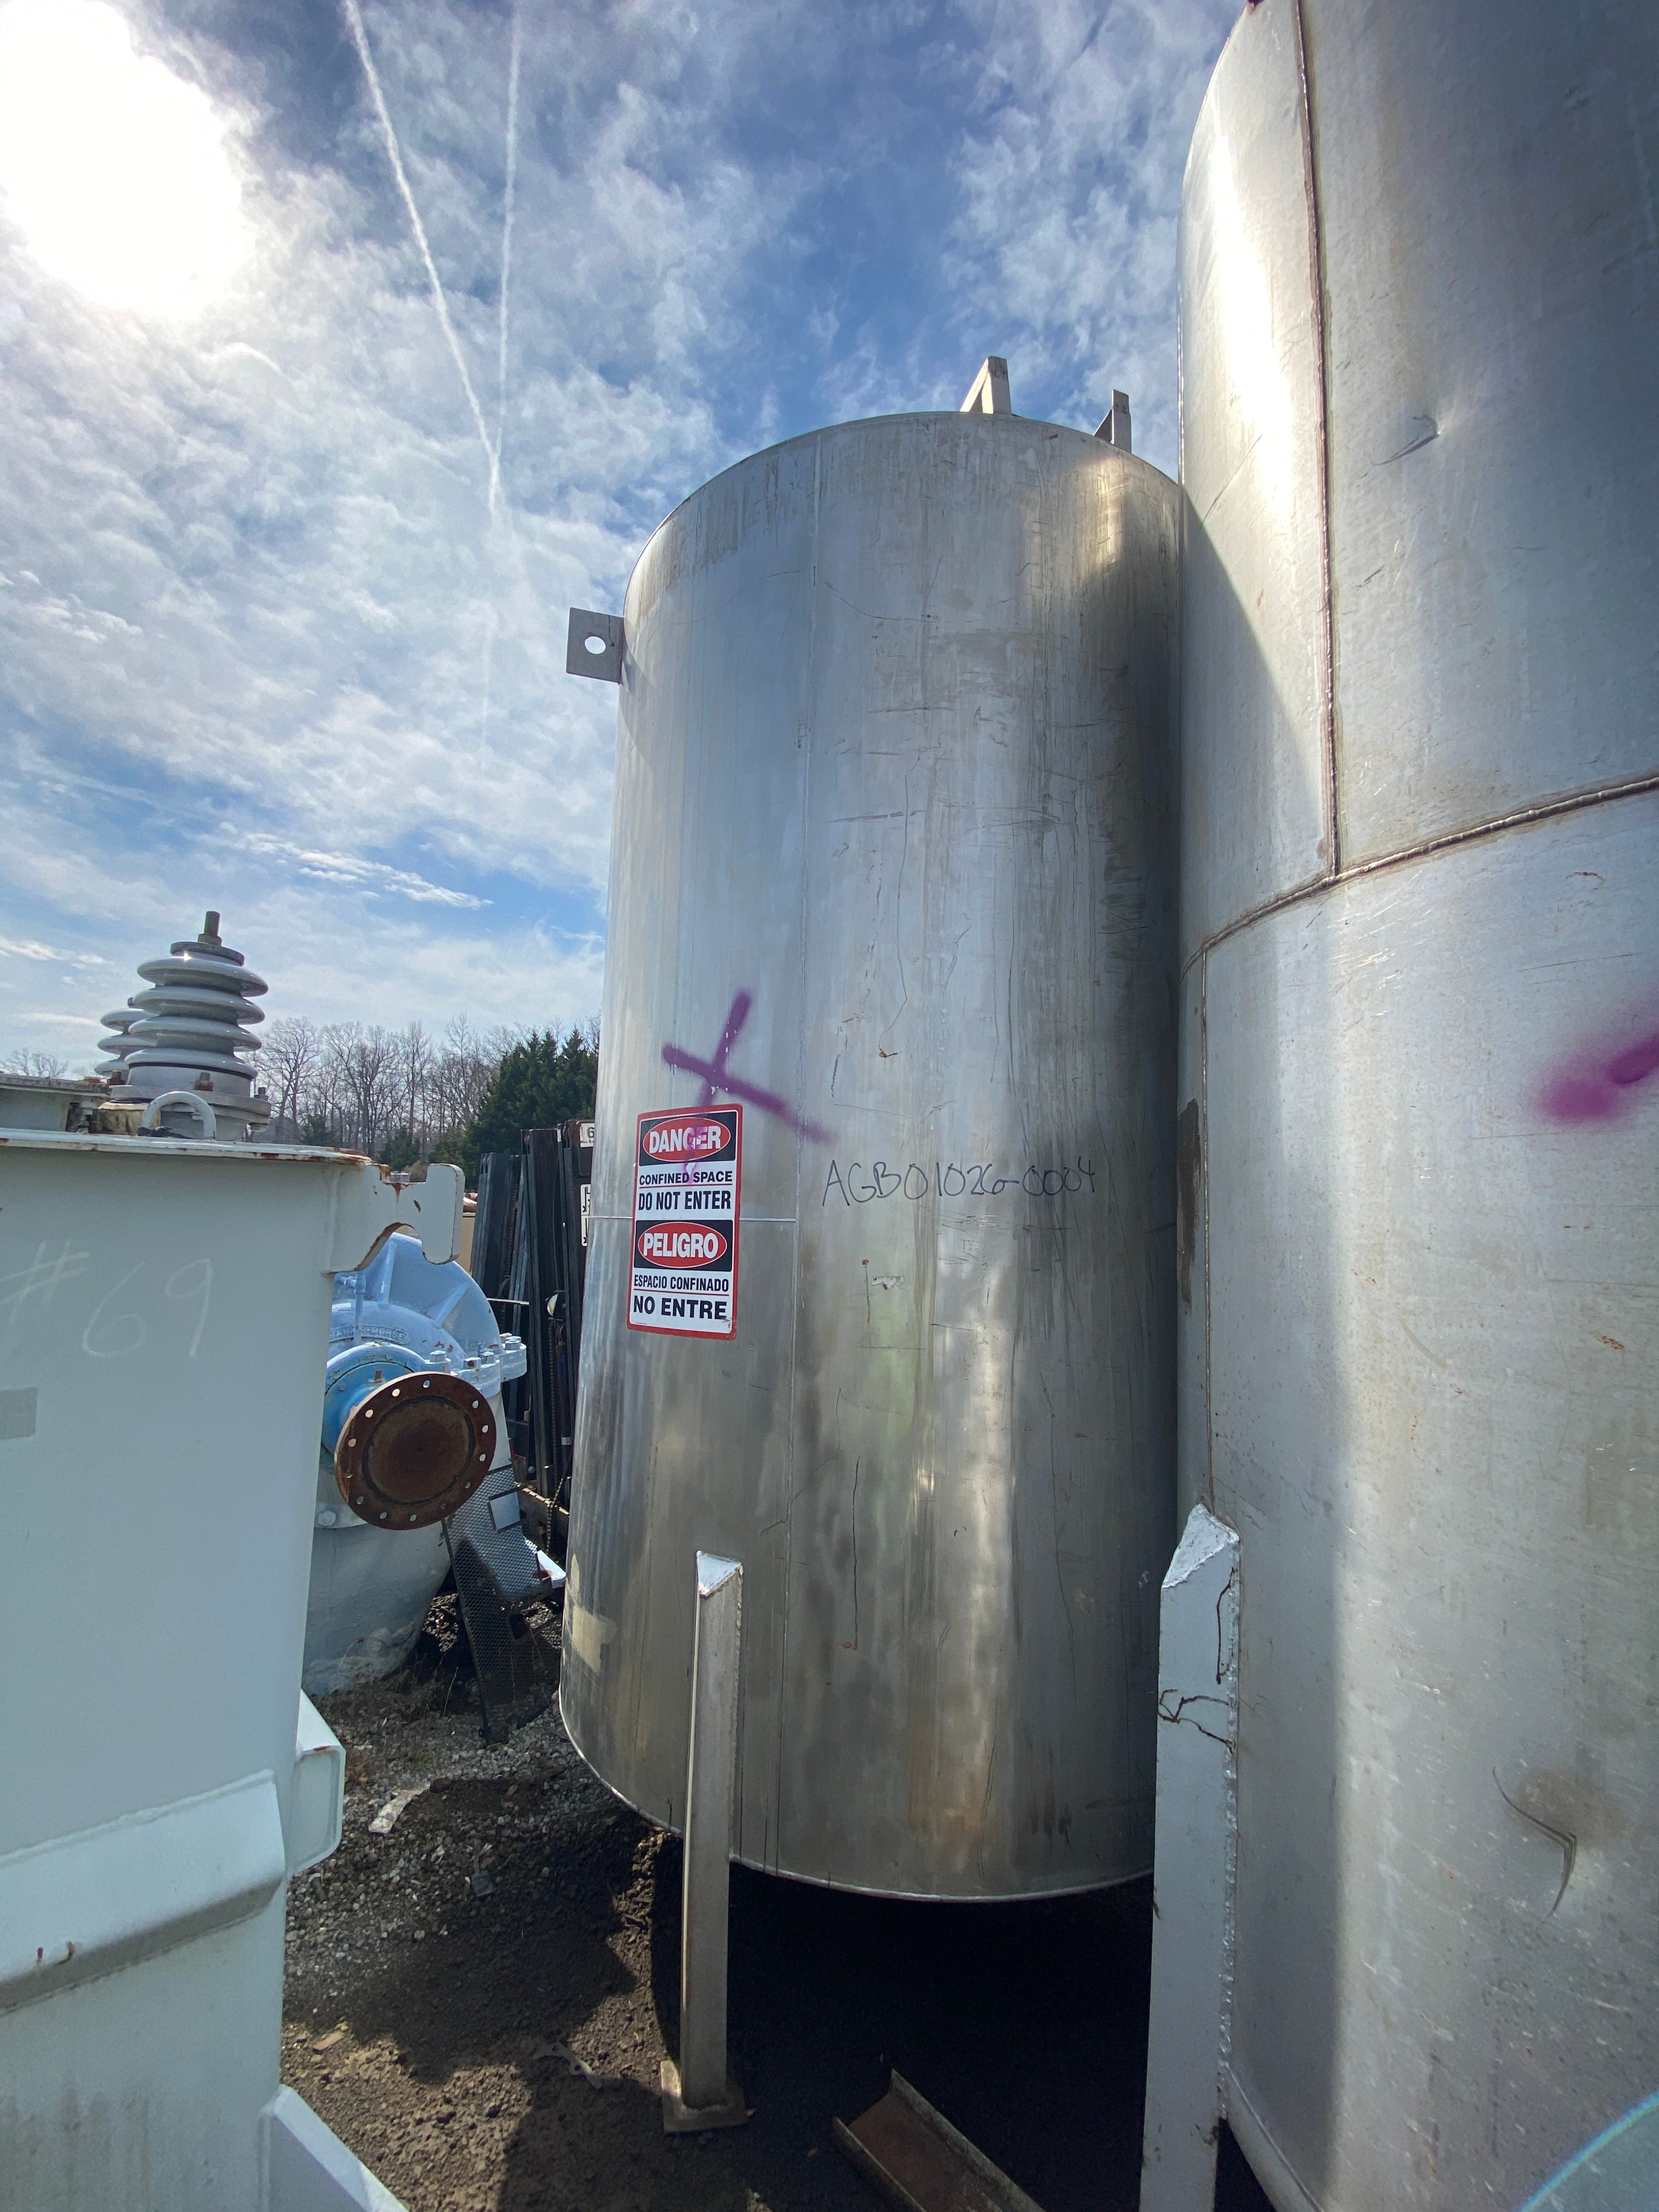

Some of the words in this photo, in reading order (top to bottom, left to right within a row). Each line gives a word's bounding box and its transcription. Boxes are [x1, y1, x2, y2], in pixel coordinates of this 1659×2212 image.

[649, 1126, 721, 1154] DANGER
[639, 1172, 690, 1186] CONFINED
[693, 1171, 733, 1183] SPACE
[638, 1192, 652, 1211] DO
[656, 1191, 681, 1210] NOT
[684, 1190, 731, 1210] ENTER
[643, 1232, 719, 1259] PELIGRO
[634, 1274, 667, 1289] ESPACIO
[670, 1277, 729, 1292] CONFINADO
[633, 1295, 656, 1314] NO
[661, 1297, 727, 1320] ENTRE
